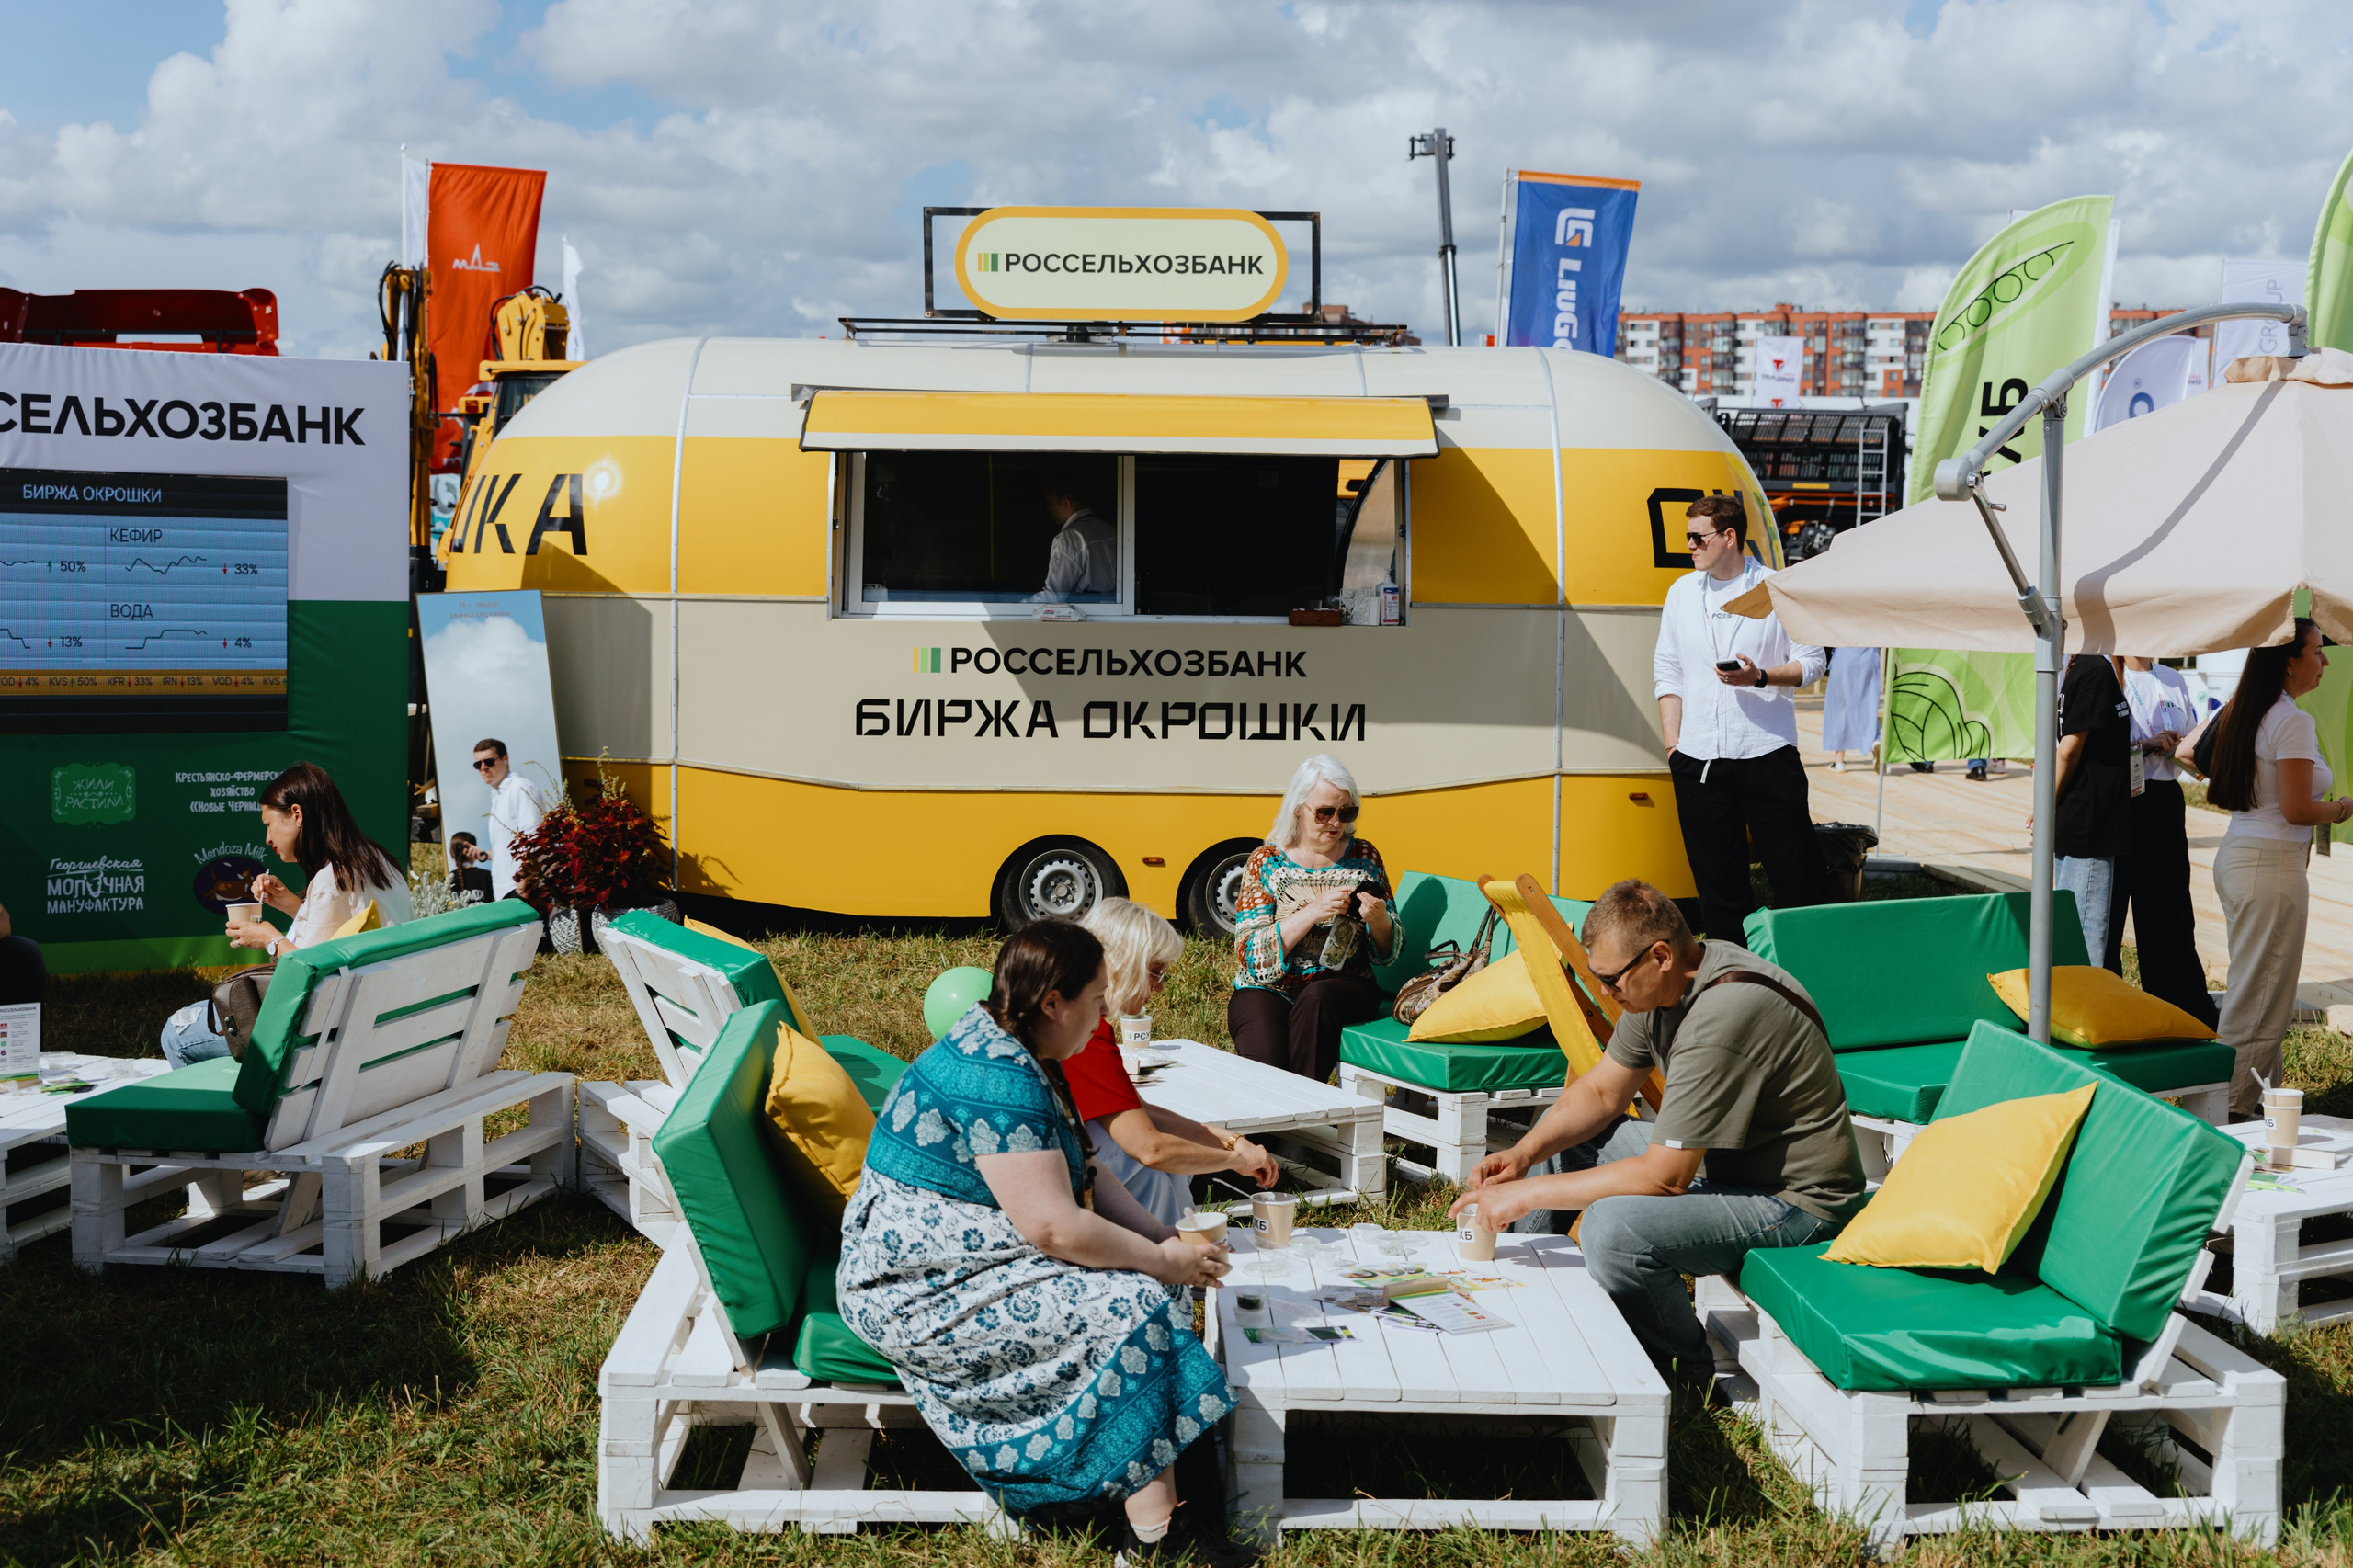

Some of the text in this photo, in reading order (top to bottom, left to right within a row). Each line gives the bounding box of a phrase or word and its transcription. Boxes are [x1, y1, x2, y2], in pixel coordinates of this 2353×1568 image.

[1006, 252, 1264, 275] РОССЕЛЬХОЗБАНК
[2259, 279, 2284, 354] GRUP
[23, 484, 162, 503] БИРЖА ОКРОШКИ
[110, 528, 163, 543] КЕФИР
[60, 561, 86, 573] 50%
[234, 563, 258, 575] 33%
[110, 604, 153, 620] ВОДА
[60, 636, 83, 648] 13%
[234, 637, 252, 648] 4%
[951, 647, 1308, 678] РОССЕЛЬХОЗБАНК
[25, 677, 39, 686] 4%
[49, 677, 68, 686] KVS
[77, 677, 97, 686] 50%
[108, 677, 125, 686] KFR
[134, 677, 153, 686] 33%
[162, 677, 177, 686] IRN
[187, 677, 203, 686] 13%
[212, 677, 233, 686] VOD
[241, 677, 254, 686] 4%
[263, 677, 281, 686] KVS
[856, 699, 1367, 741] БИРЖА ОКРОШКИ
[73, 778, 115, 790] ЖИЛИ
[210, 785, 256, 797] ХОЗЯЙСТВО
[64, 795, 126, 810] РАСТИЛИ
[193, 841, 268, 865] Mendoza Milk
[49, 855, 143, 873] Георгиевская
[47, 897, 144, 915] МАНУФАКТУРА
